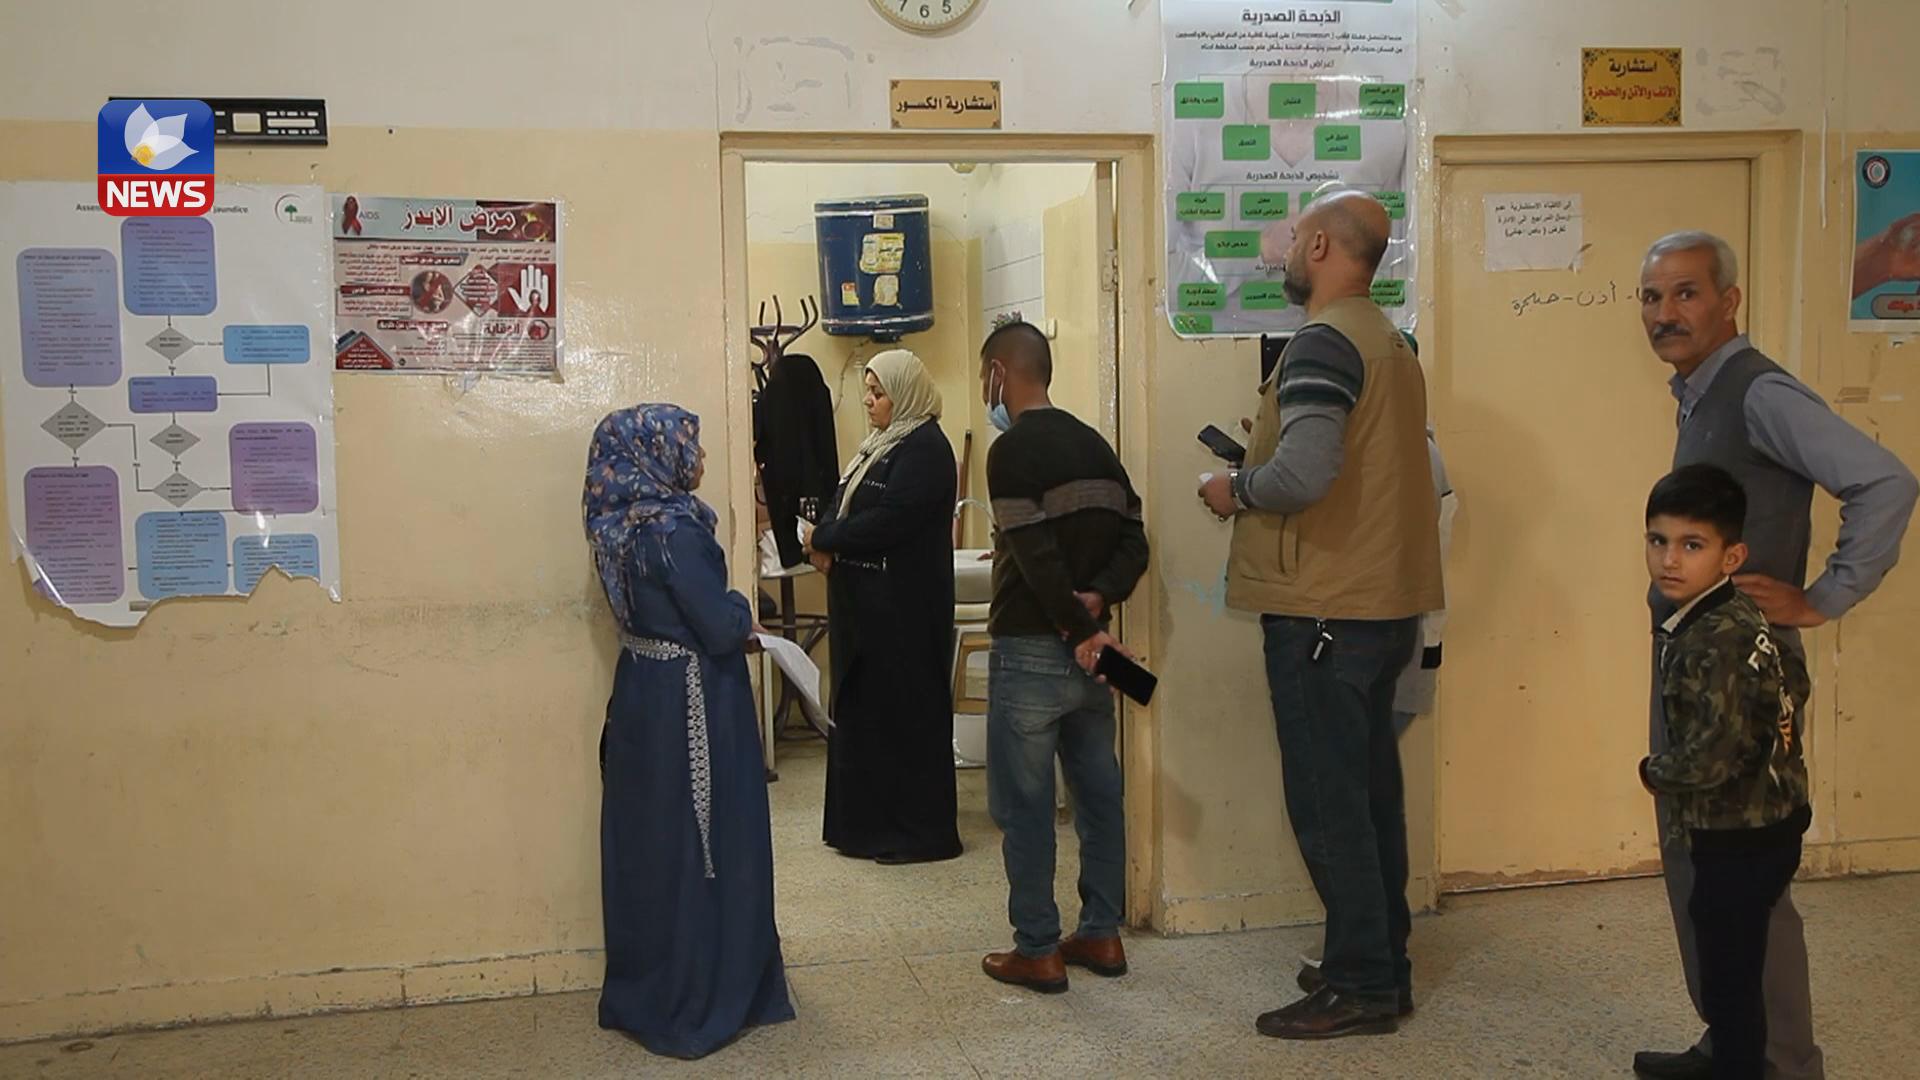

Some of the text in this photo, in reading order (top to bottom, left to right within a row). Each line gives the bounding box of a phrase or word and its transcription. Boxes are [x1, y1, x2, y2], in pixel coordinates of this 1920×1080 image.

[920, 5, 930, 18] 6
[942, 0, 952, 14] 5
[1242, 9, 1296, 26] الصدرية
[896, 96, 942, 113] الكسور
[403, 203, 516, 234] مرض الايدز
